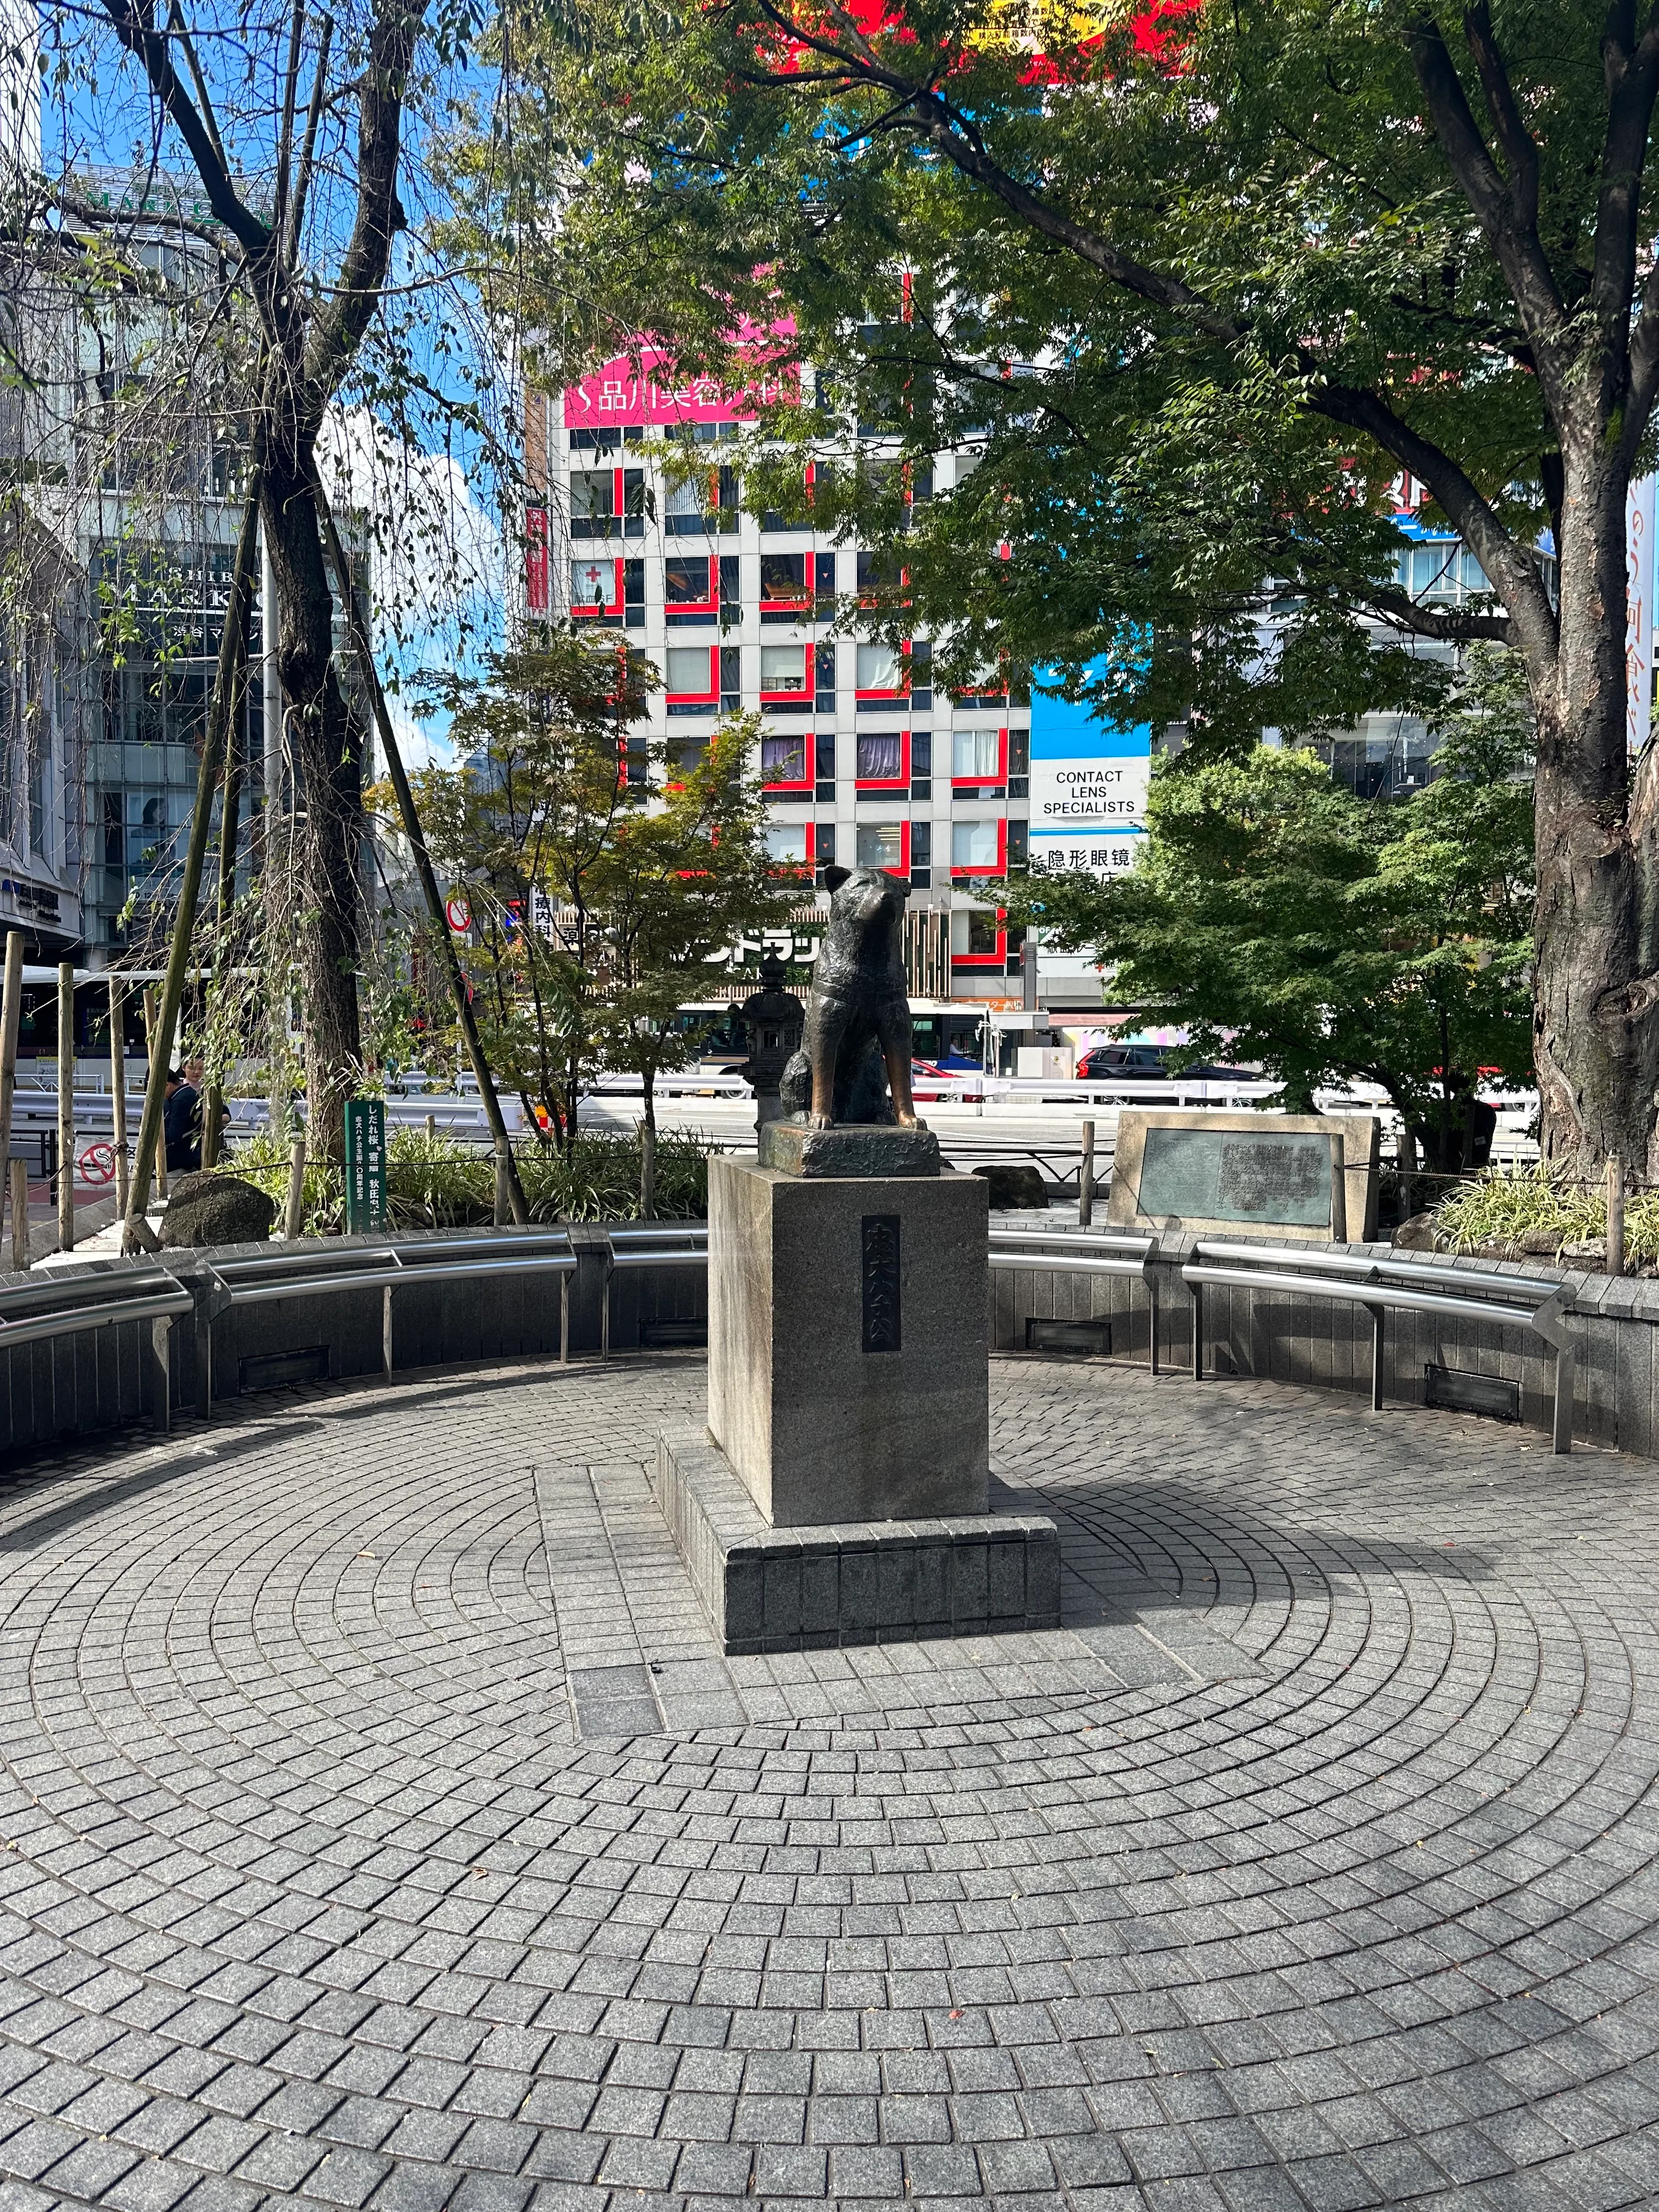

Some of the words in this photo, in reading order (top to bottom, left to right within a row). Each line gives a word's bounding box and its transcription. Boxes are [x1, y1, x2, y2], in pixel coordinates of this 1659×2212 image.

[1057, 770, 1123, 783] CONTACT
[1071, 786, 1107, 798] LENS
[1043, 800, 1135, 814] SPECIALISTS
[1048, 848, 1130, 867] 隐形眼镜
[368, 1104, 379, 1145] しだれ桜
[368, 1152, 380, 1172] 寄贈
